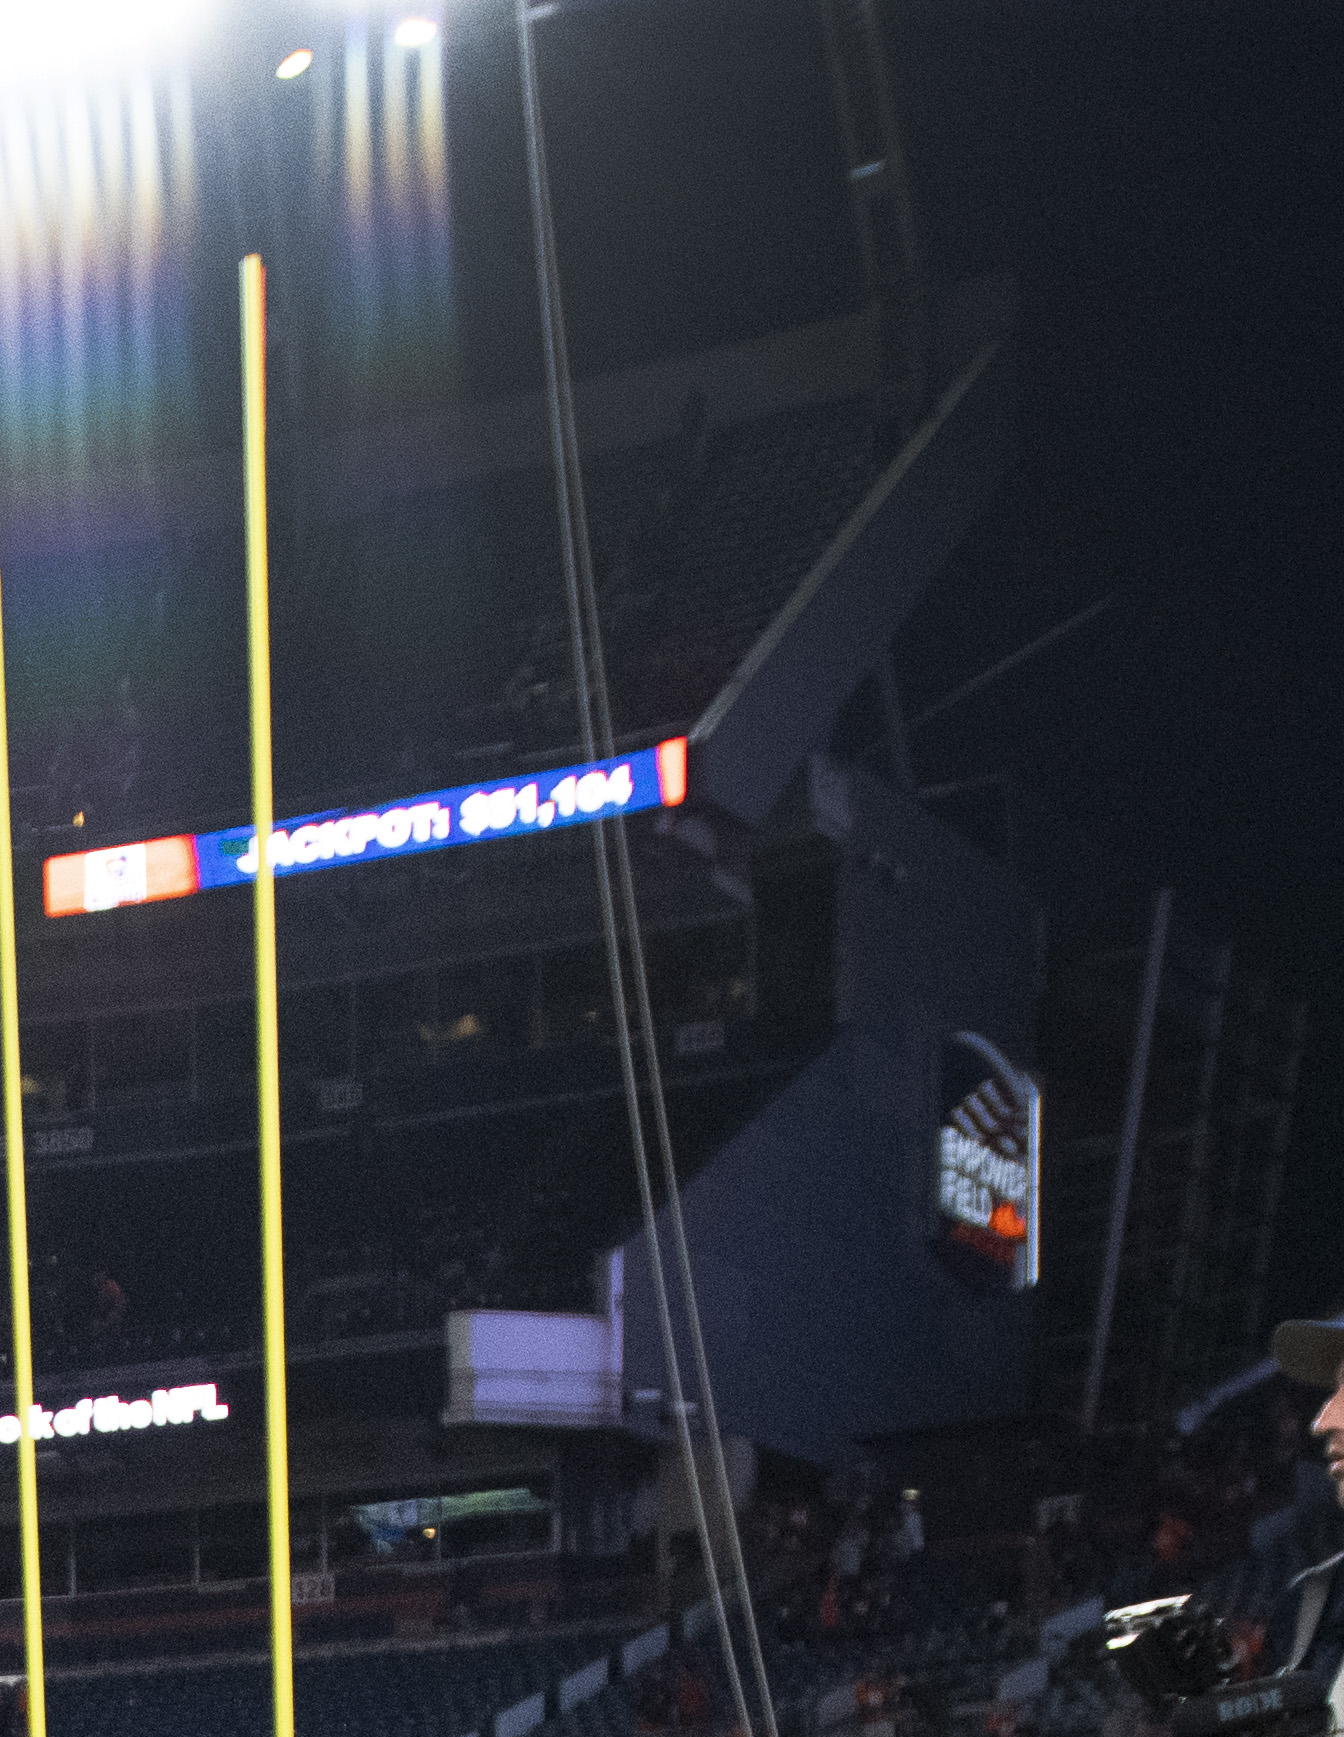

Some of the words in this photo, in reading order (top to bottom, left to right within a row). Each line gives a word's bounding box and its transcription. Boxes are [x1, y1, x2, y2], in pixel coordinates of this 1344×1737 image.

[237, 802, 451, 874] JACKPOT:
[53, 1397, 92, 1437] of
[92, 1395, 152, 1432] the
[152, 1383, 229, 1426] NFL
